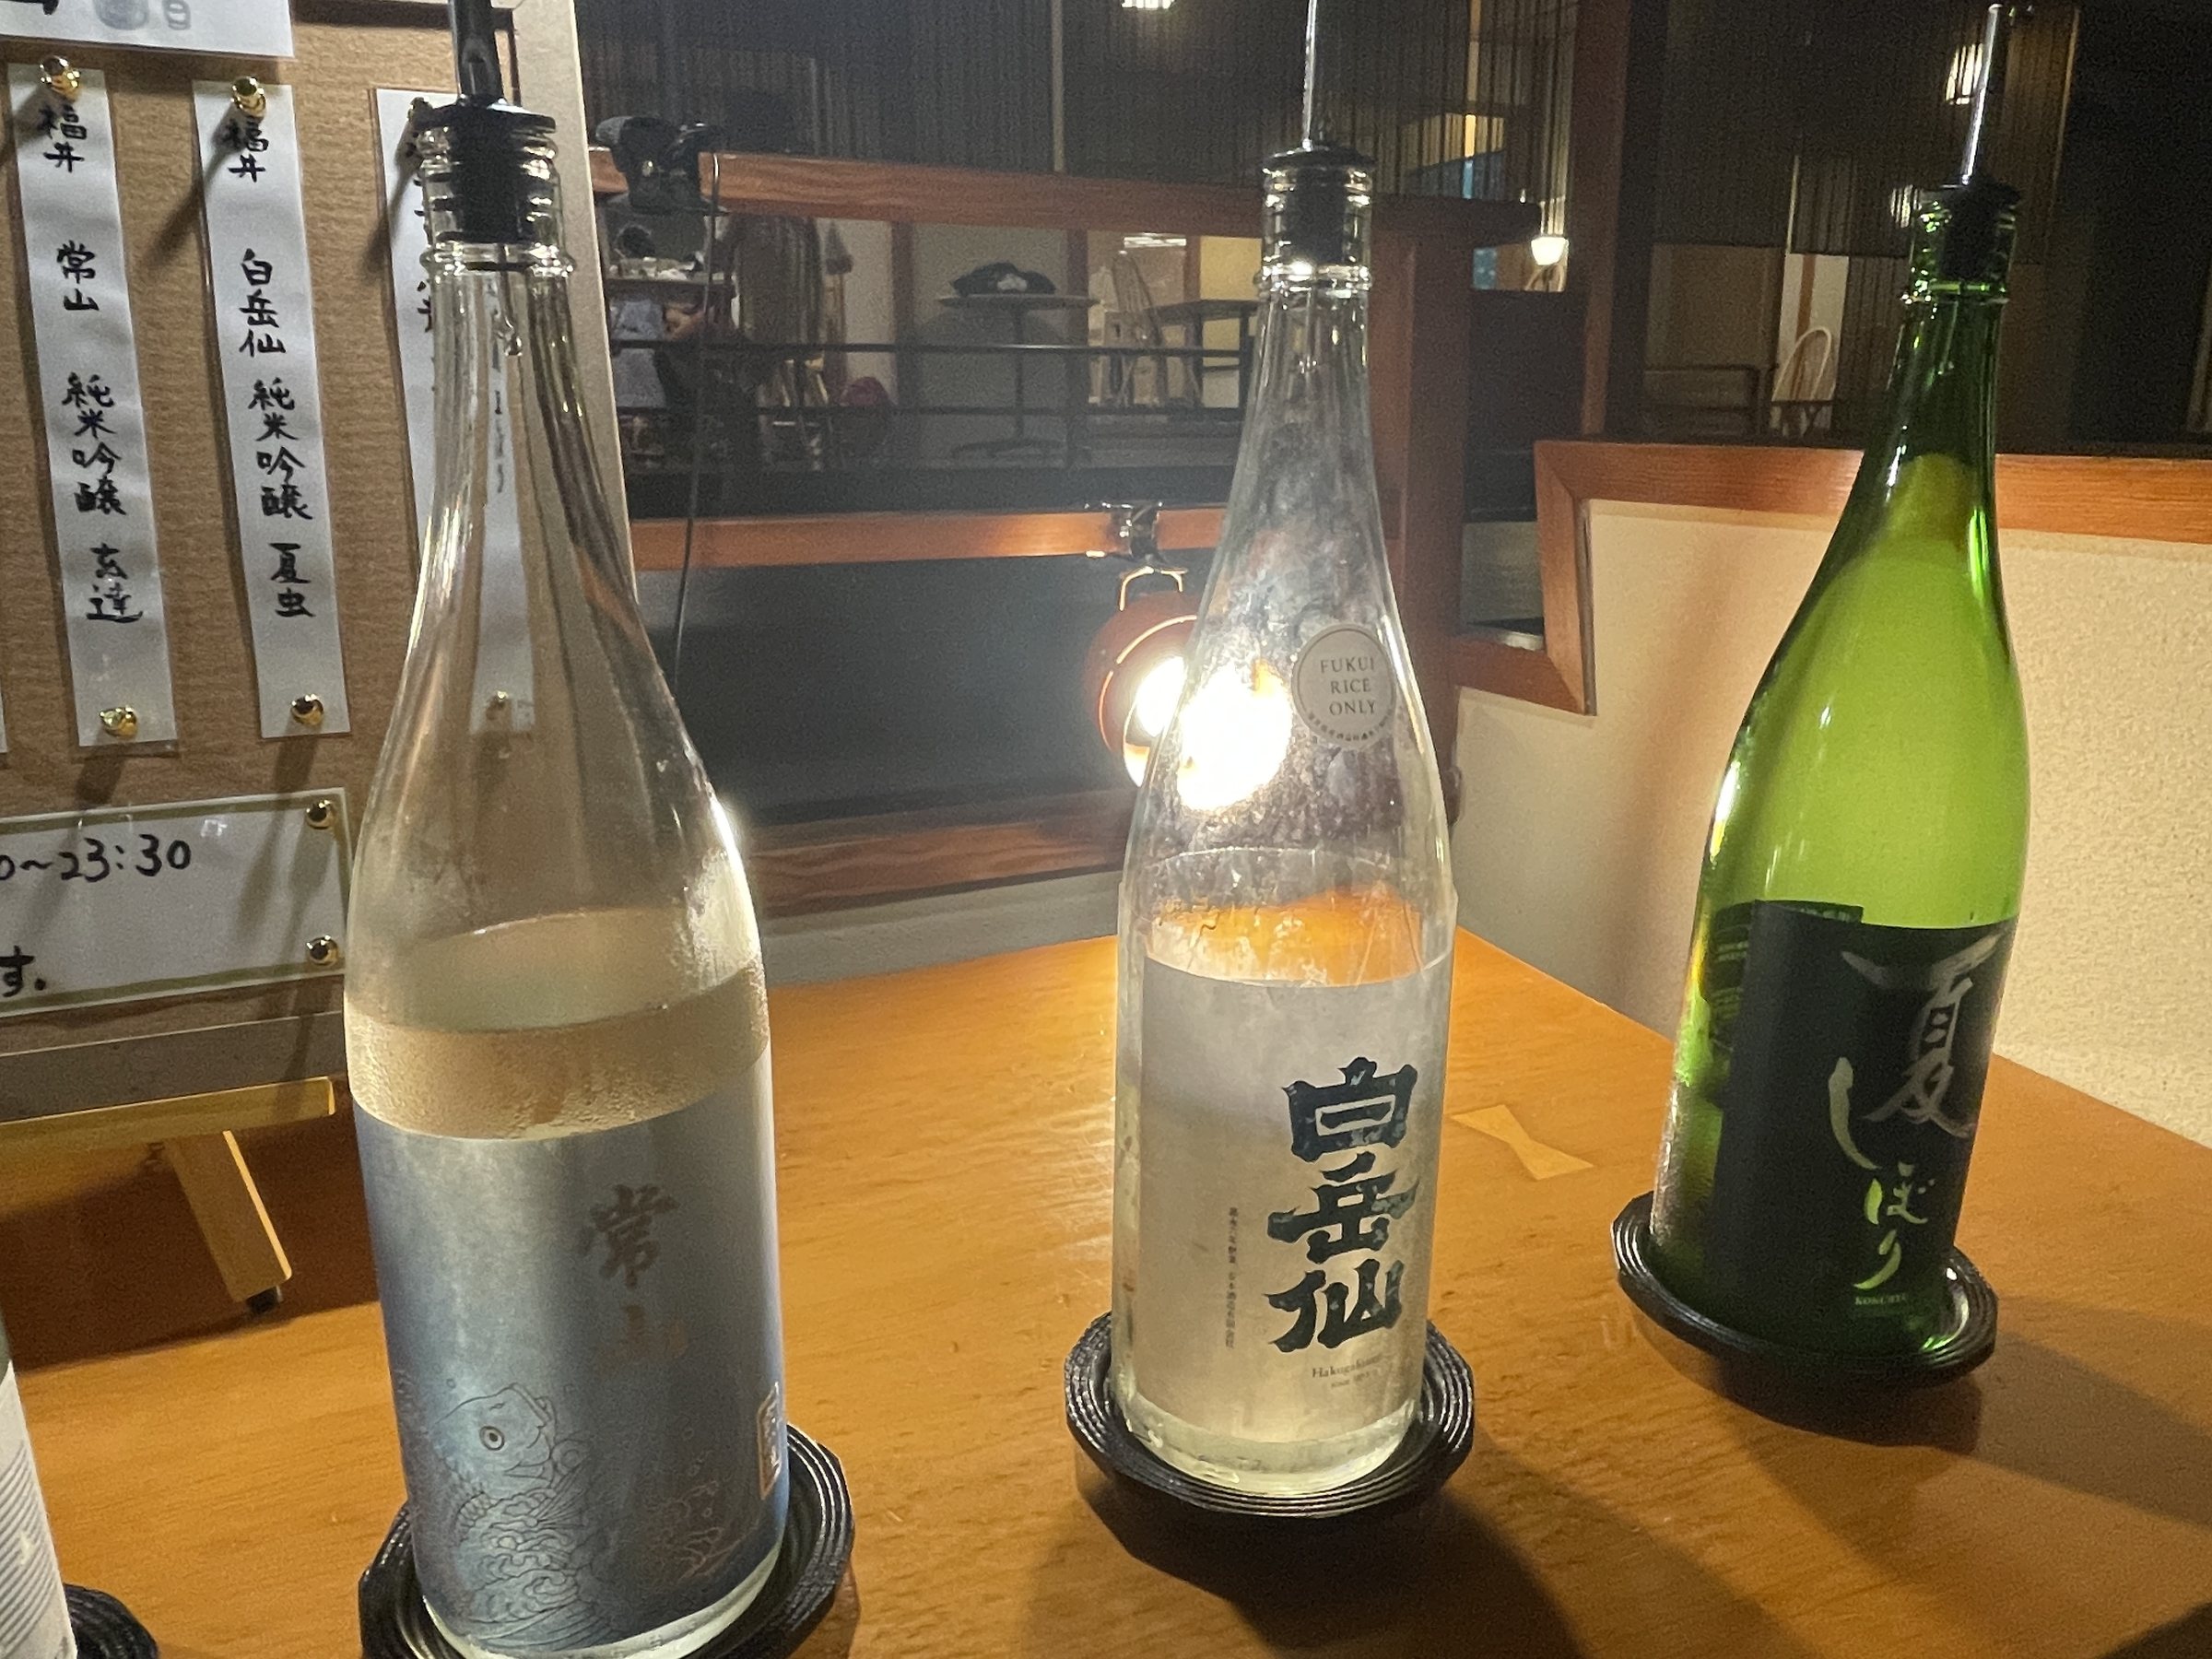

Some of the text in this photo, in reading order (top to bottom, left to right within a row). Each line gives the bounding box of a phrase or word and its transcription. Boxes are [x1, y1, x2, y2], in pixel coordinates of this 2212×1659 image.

[37, 103, 144, 624] 福井 常山 純米吟醸 玄達
[224, 115, 316, 618] 福井 白岳仙 純米吟醸 夏虫
[1320, 656, 1375, 674] FUKUI
[1328, 700, 1377, 716] ONLY
[1330, 677, 1372, 695] RICE
[1265, 1056, 1420, 1353] 白岳仙
